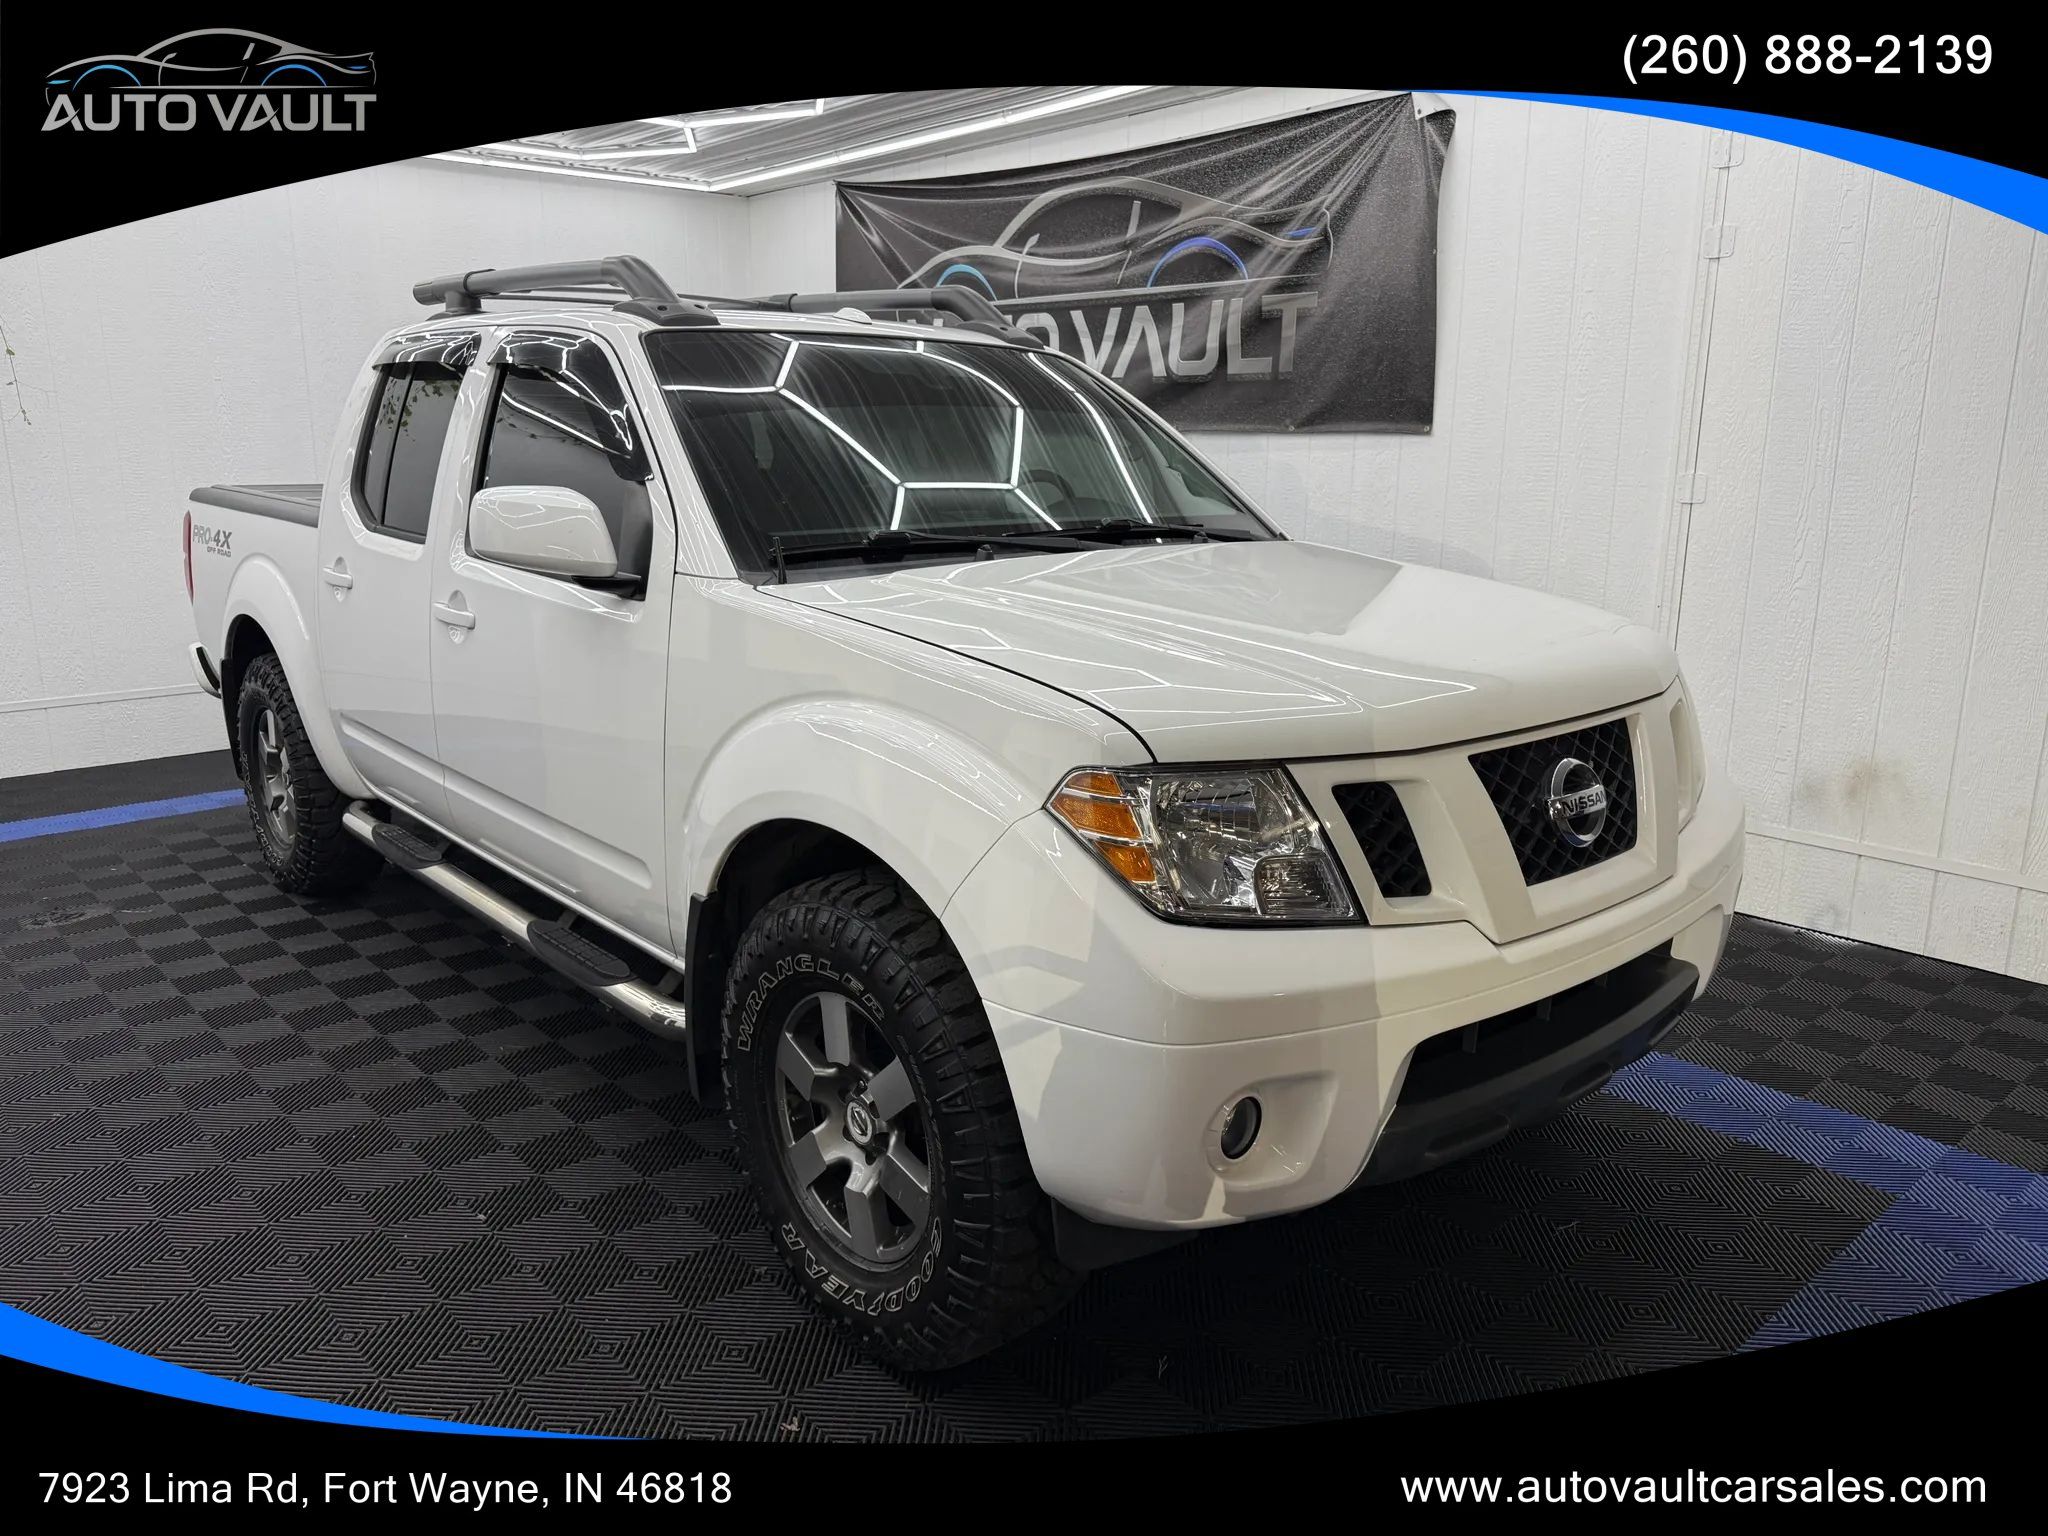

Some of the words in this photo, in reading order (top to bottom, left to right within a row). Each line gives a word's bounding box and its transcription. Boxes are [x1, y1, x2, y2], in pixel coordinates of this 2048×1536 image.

[1069, 290, 1320, 380] VAULT
[1561, 789, 1607, 816] NISSAN
[737, 953, 885, 1052] WRANGLER
[781, 1215, 943, 1317] GOODYEAR
